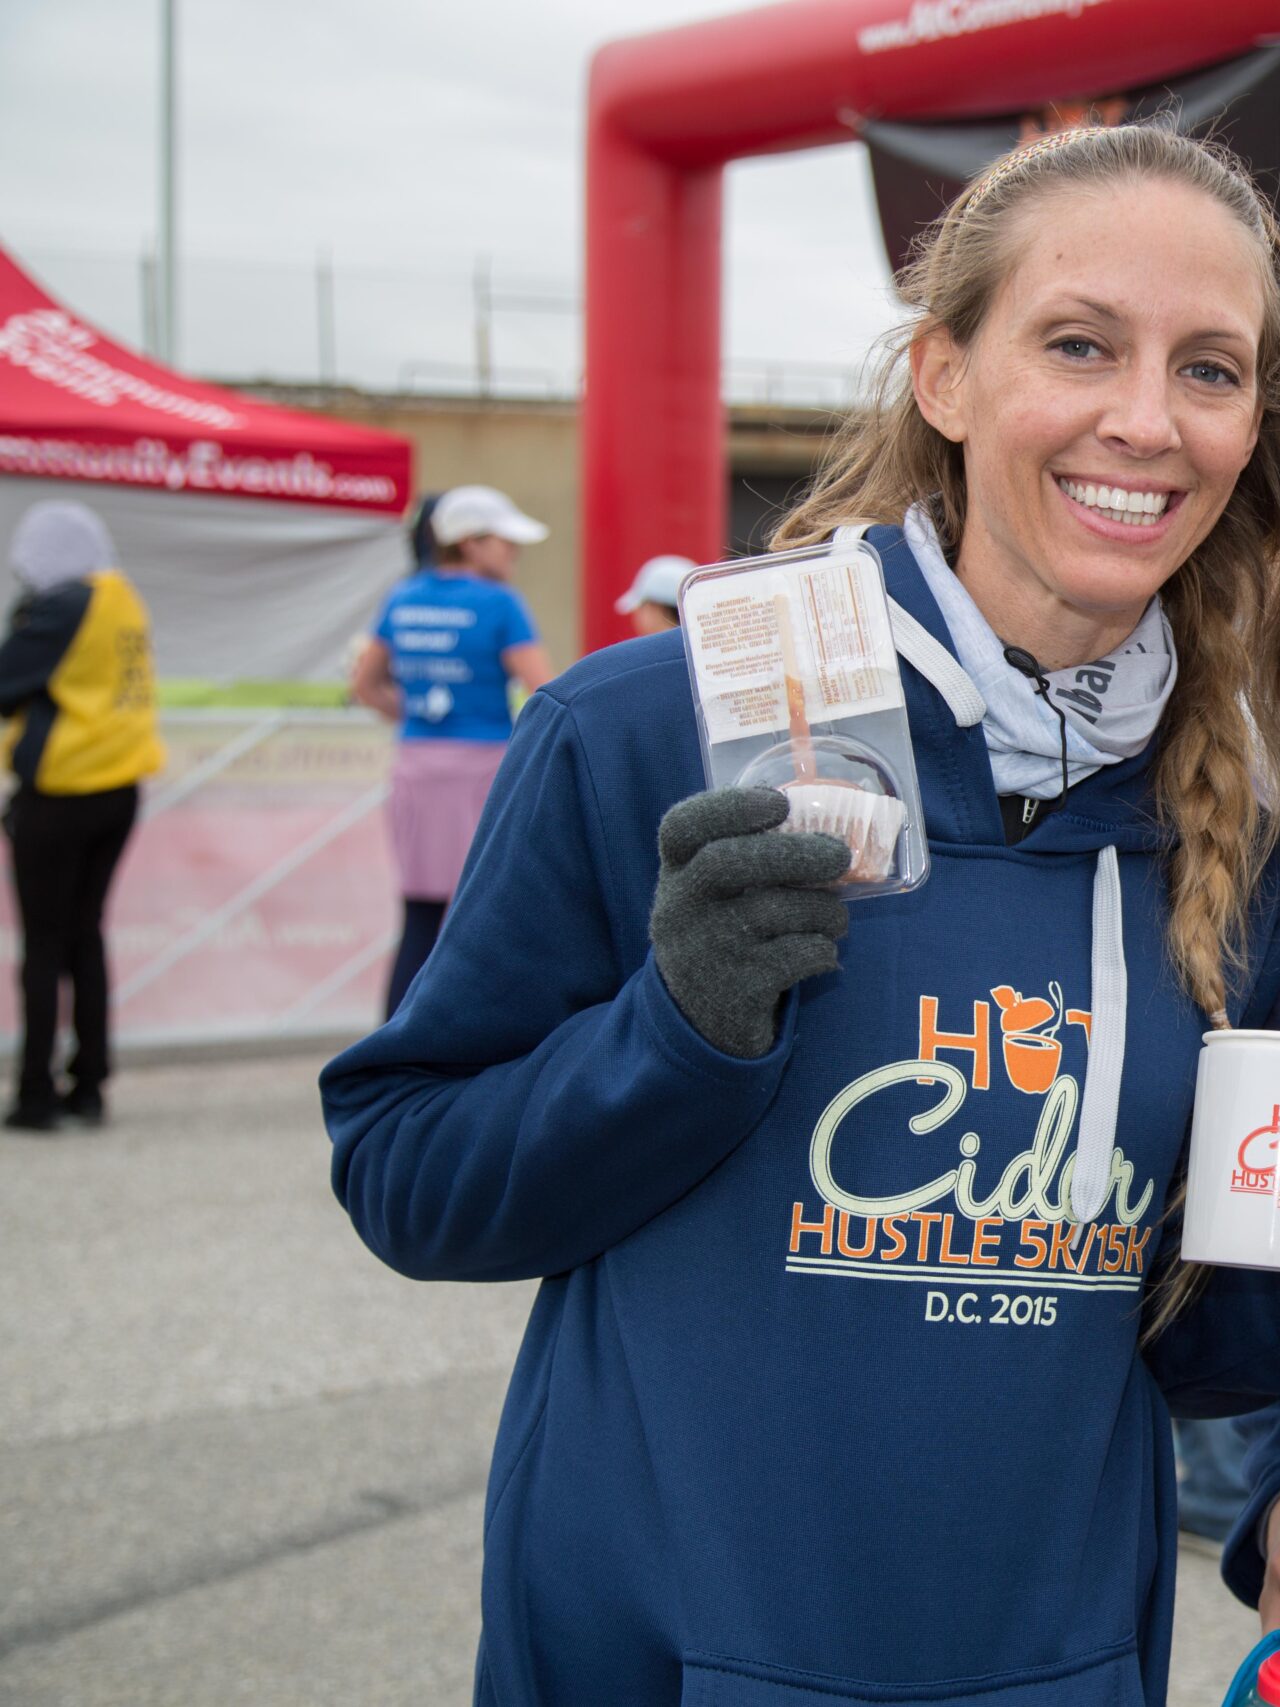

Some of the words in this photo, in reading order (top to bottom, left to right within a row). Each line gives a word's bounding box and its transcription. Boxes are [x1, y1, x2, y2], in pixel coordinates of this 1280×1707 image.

[787, 1202, 1004, 1266] HUSTLE
[1013, 1219, 1152, 1274] 5K/15K
[925, 1291, 981, 1323] D.C.
[989, 1294, 1058, 1326] 2015
